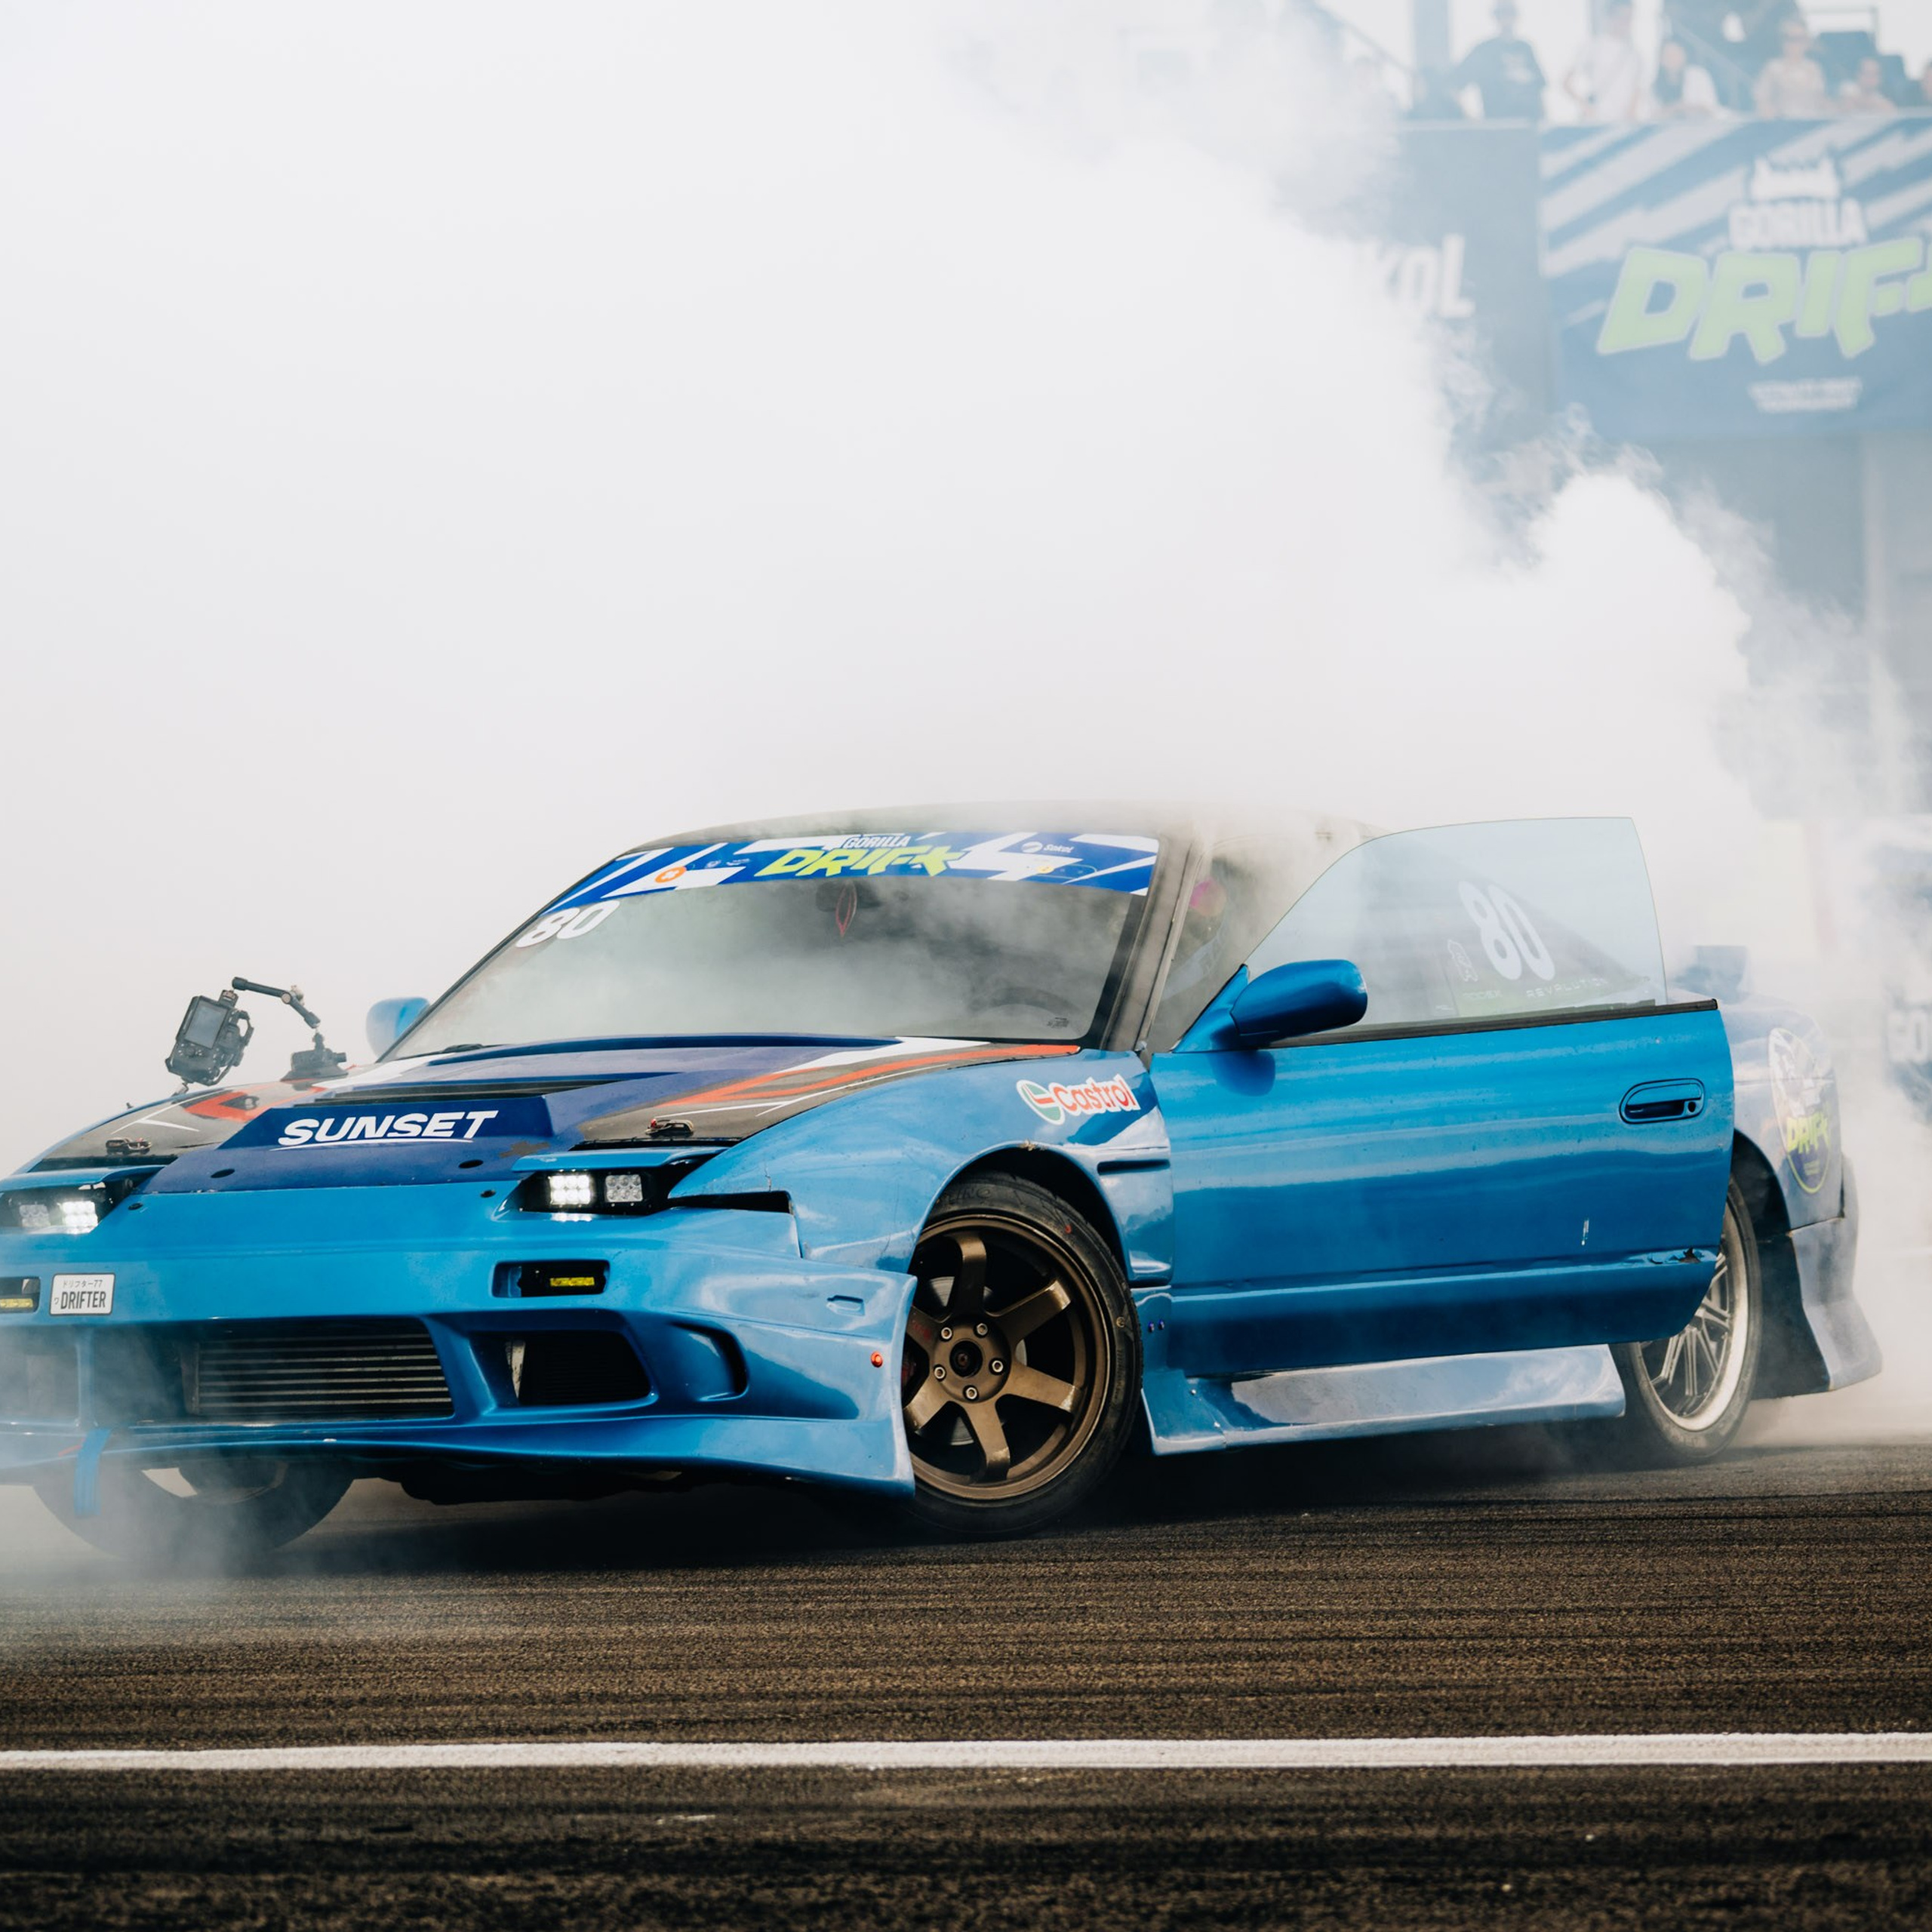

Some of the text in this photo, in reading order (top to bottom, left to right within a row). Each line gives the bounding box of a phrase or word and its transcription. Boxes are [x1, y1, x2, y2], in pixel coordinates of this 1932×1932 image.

[843, 835, 912, 848] GORILLA
[754, 844, 965, 877] DRIFT
[515, 900, 620, 948] 80
[1458, 880, 1555, 980] 80
[1051, 1077, 1138, 1113] Castrol
[278, 1109, 500, 1146] SUNSET
[61, 1291, 106, 1309] DRIFTER
